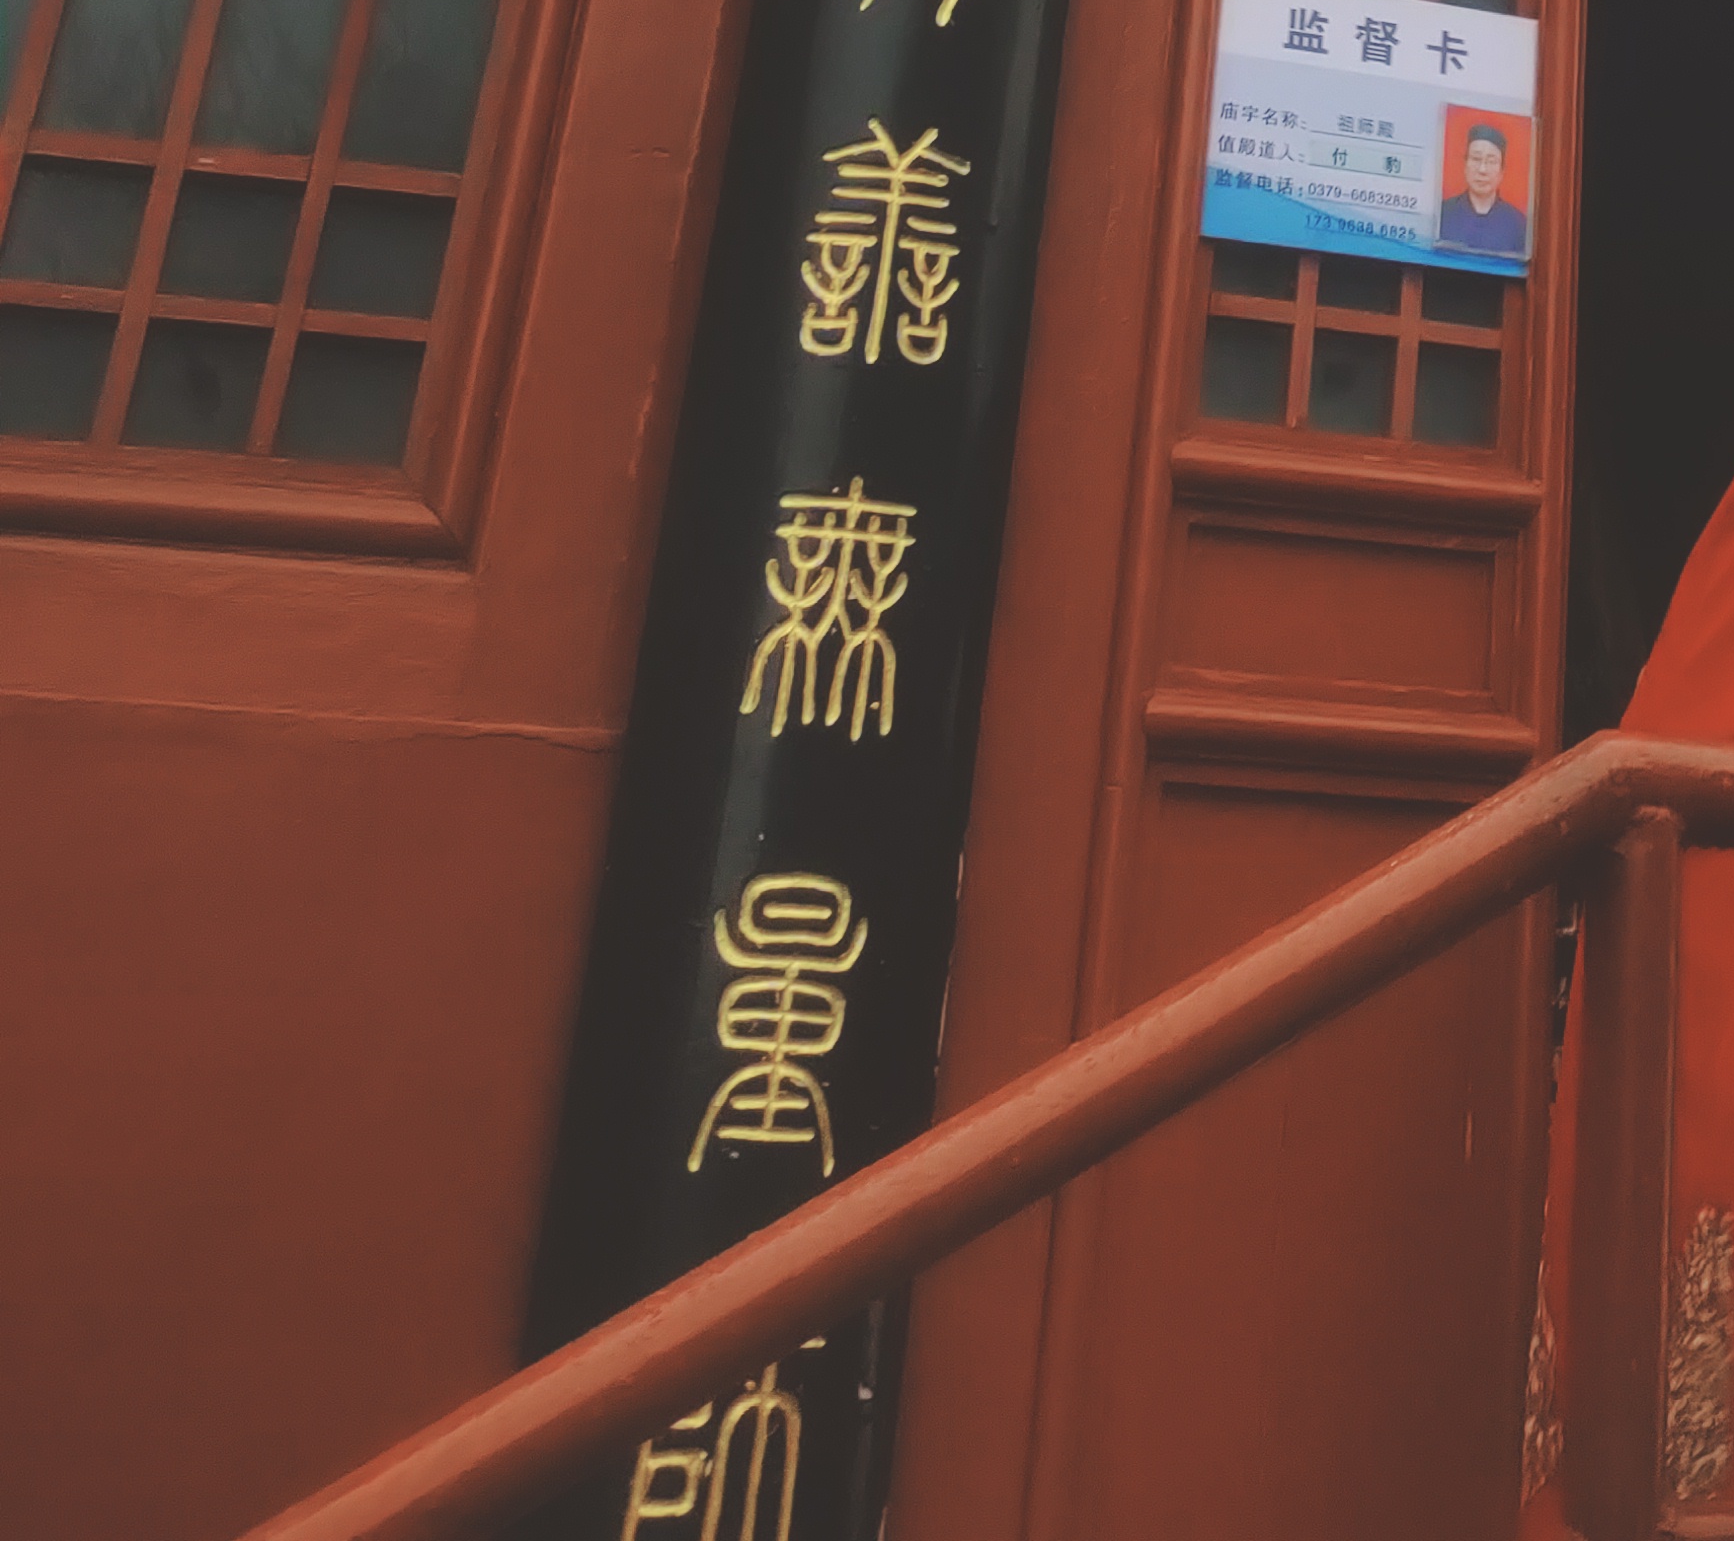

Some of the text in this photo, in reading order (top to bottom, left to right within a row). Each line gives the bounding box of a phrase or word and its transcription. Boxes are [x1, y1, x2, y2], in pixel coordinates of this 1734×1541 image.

[1282, 7, 1469, 75] 监督卡
[1336, 113, 1396, 139] 祖师殿
